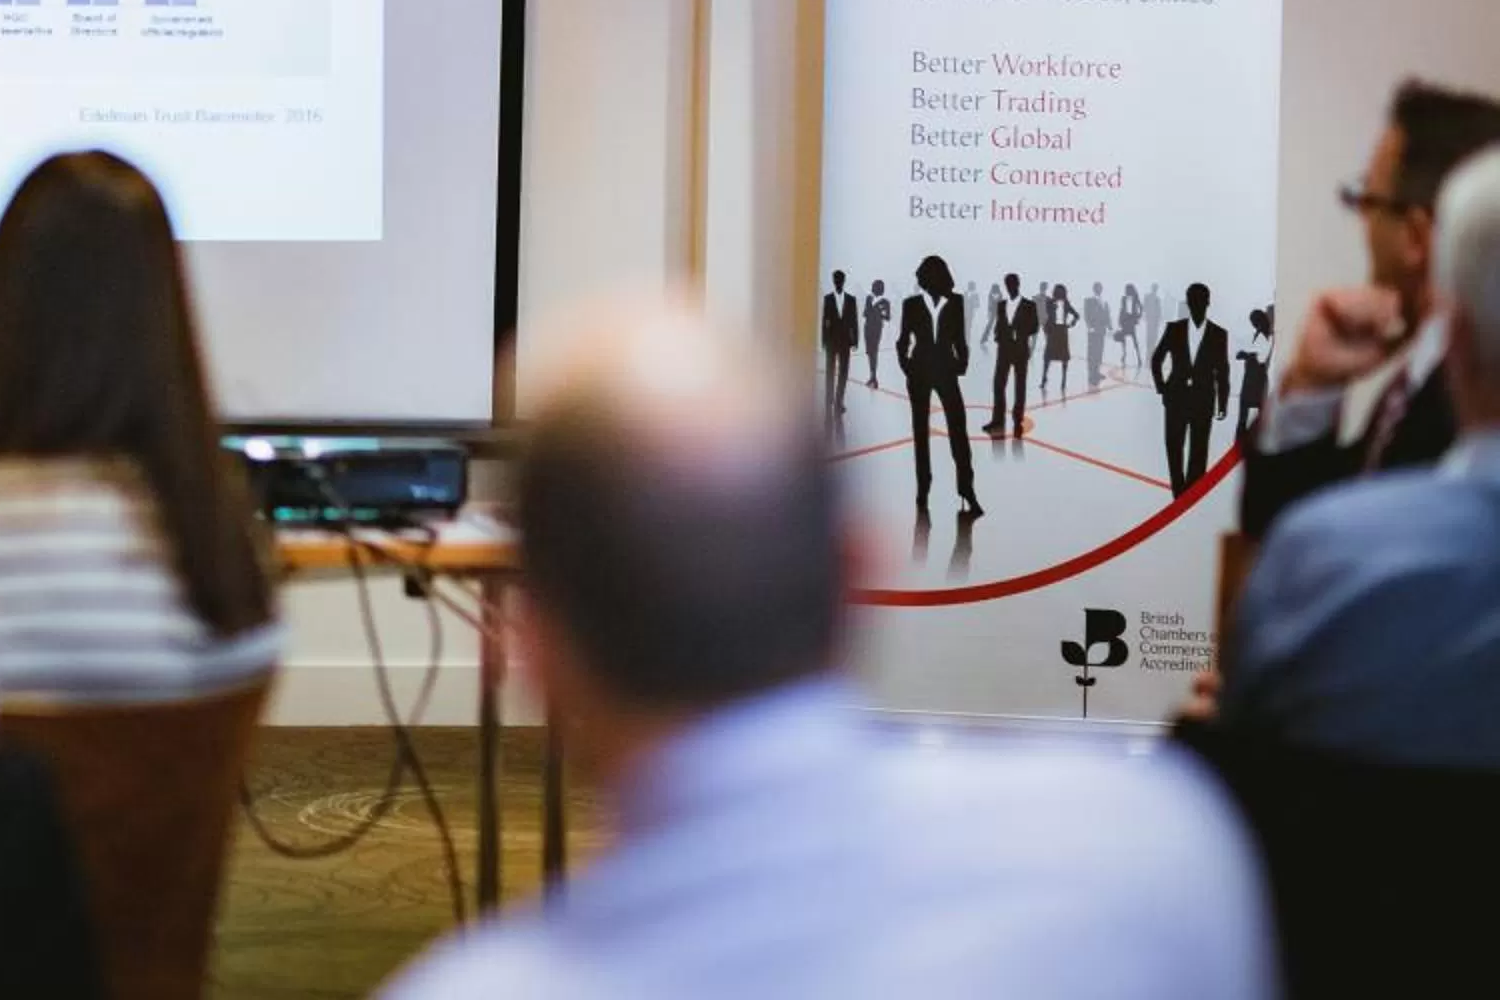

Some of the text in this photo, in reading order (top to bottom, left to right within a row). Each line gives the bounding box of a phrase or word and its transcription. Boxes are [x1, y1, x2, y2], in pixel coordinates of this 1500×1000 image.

[911, 50, 1122, 79] Better Workforce
[911, 87, 1088, 120] Better Trading
[910, 123, 1072, 151] Better Global
[910, 160, 1123, 189] Better Connected
[908, 196, 1106, 225] Better Informed
[1139, 625, 1207, 641] Chambers
[1141, 611, 1185, 626] British
